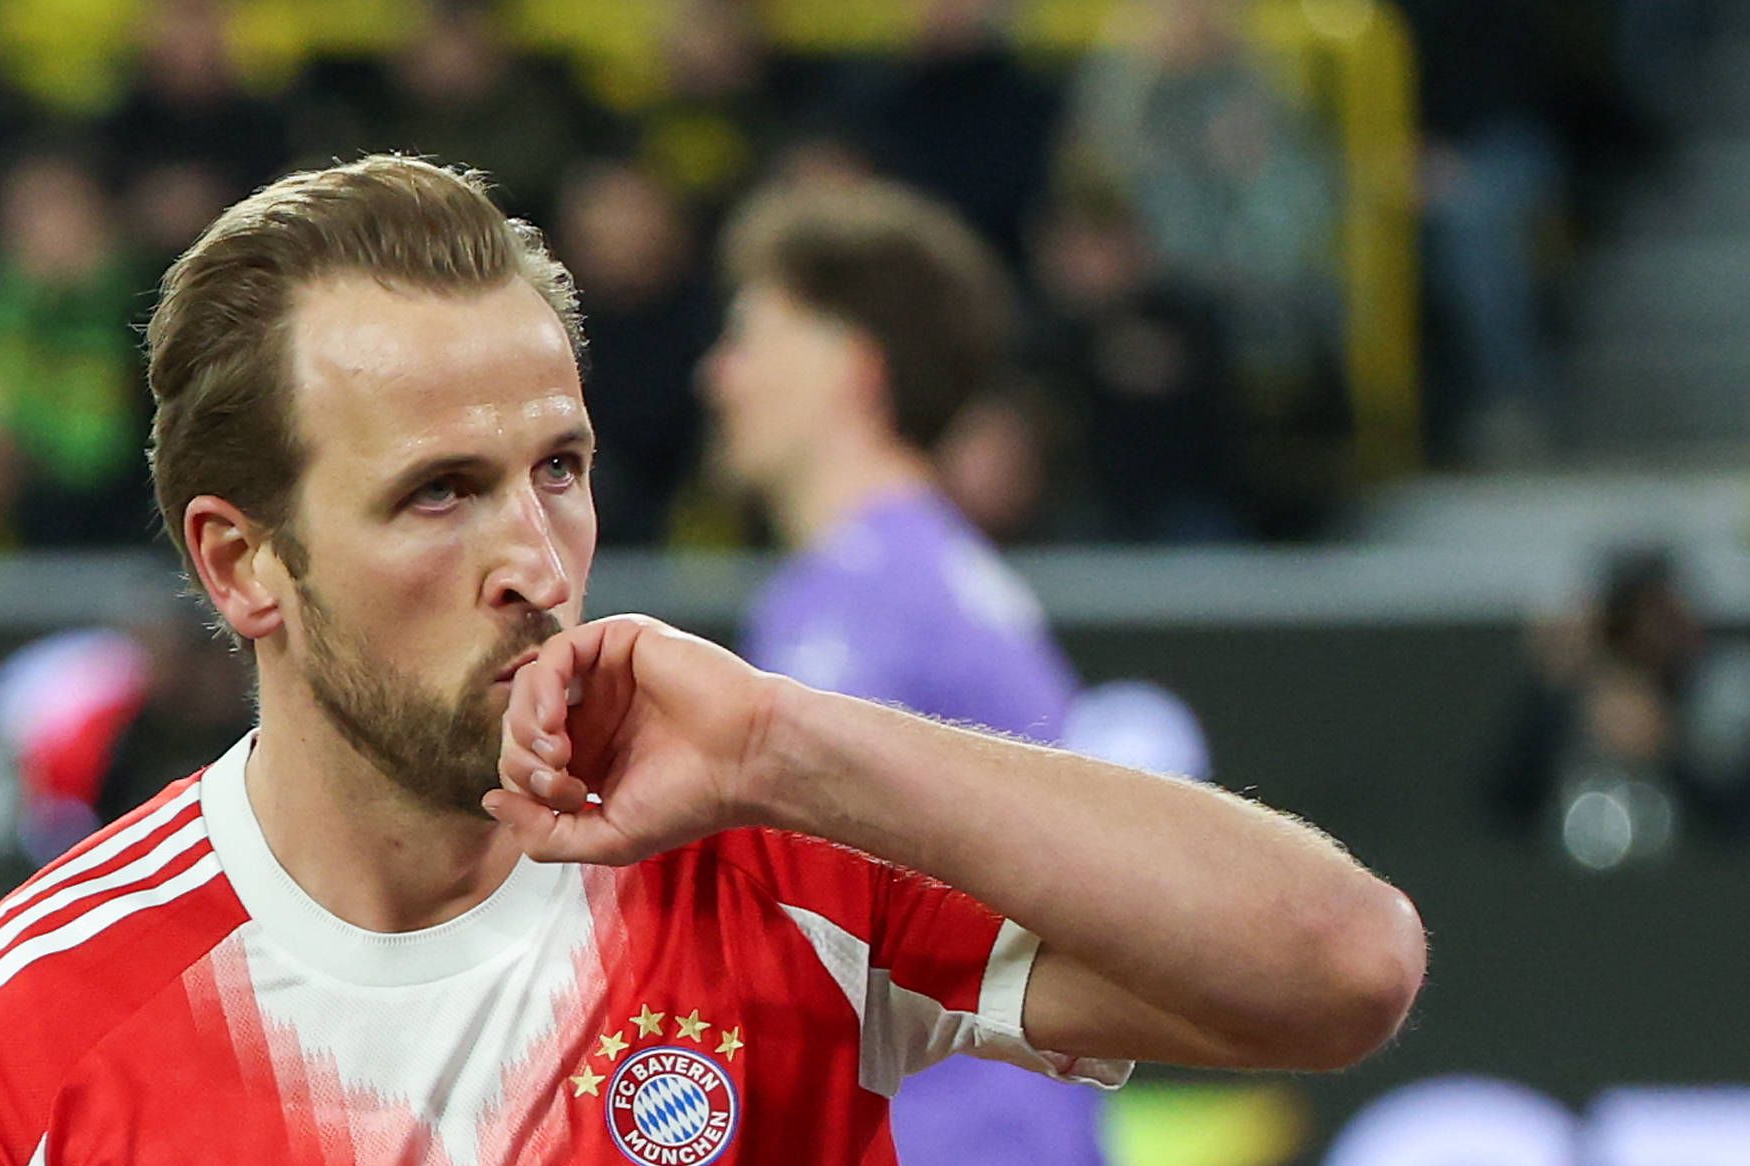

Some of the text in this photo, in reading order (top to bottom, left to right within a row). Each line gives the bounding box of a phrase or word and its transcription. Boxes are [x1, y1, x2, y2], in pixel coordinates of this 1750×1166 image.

[614, 1055, 720, 1110] FC BAYERN
[623, 1111, 729, 1165] MÜNCHEN
